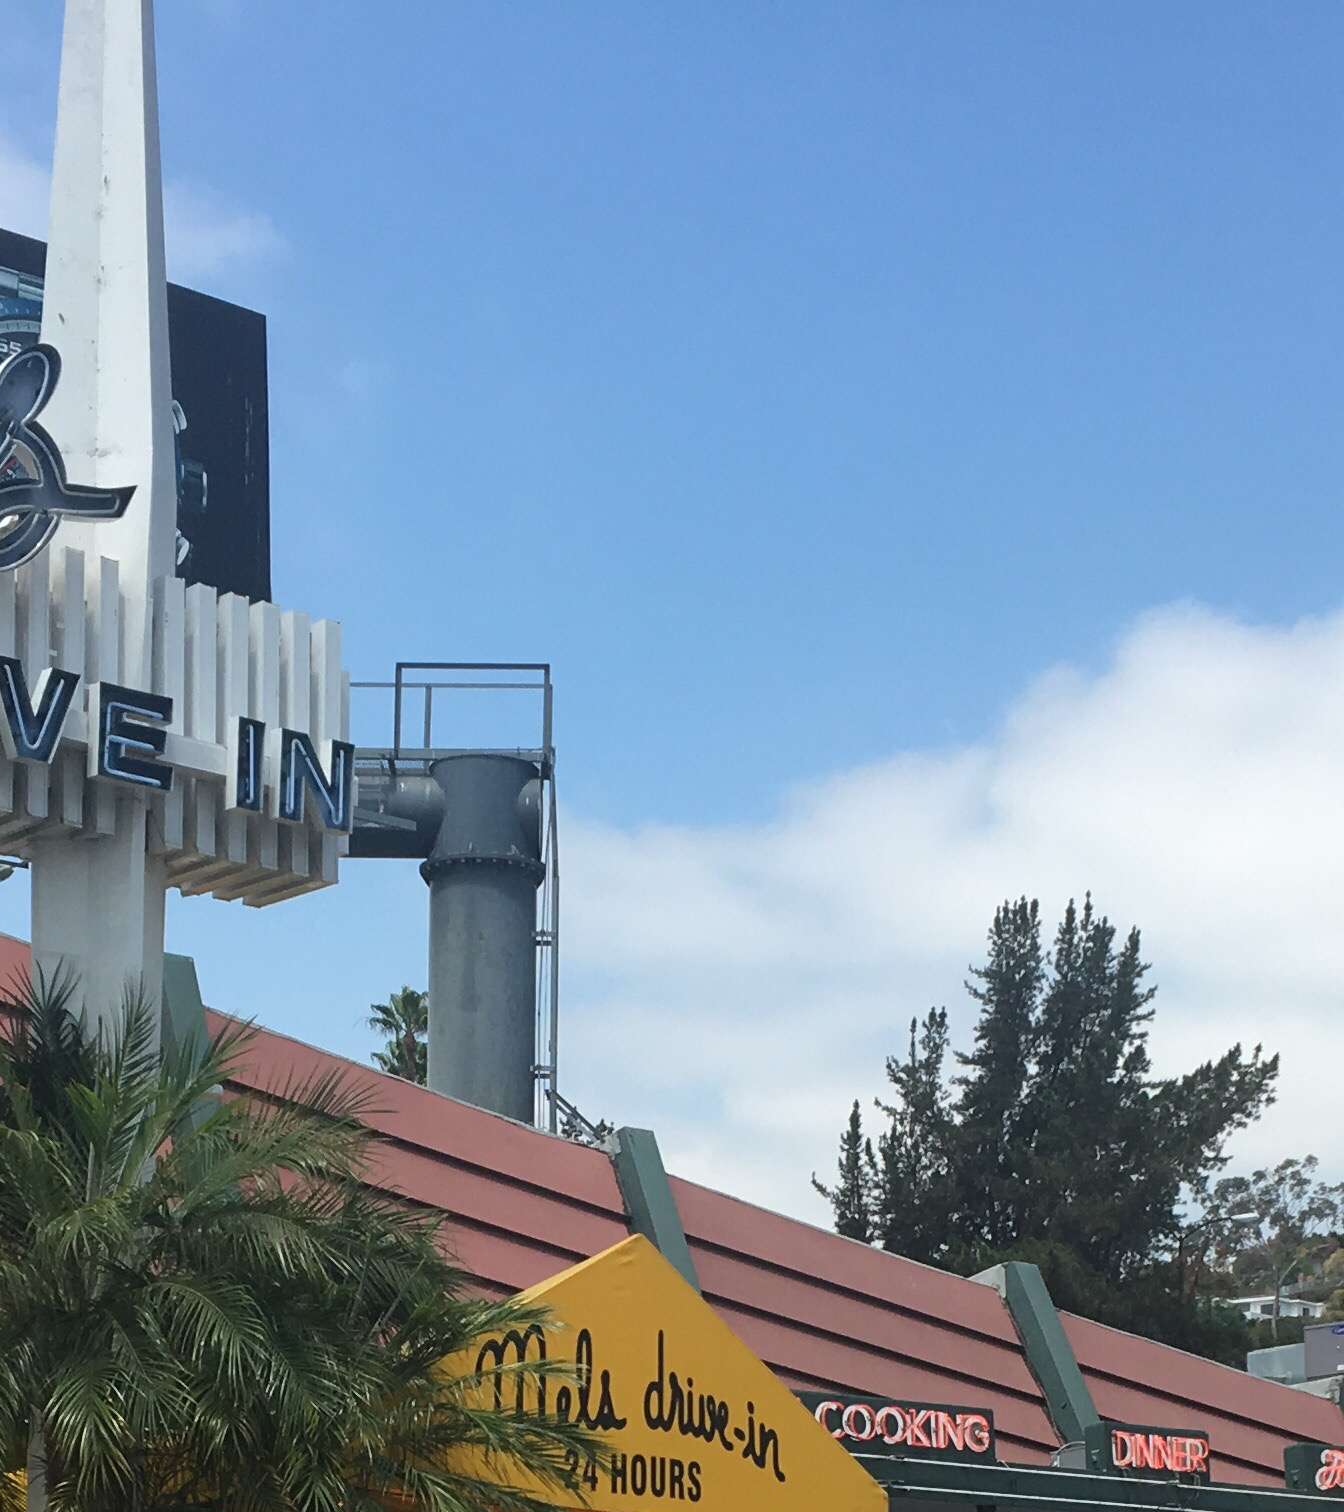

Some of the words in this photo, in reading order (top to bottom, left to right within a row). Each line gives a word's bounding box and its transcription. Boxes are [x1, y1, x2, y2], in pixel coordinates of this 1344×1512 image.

[226, 715, 356, 836] IN
[475, 1323, 627, 1430] Mels
[643, 1329, 786, 1483] drive-in
[814, 1400, 991, 1453] COOKING
[611, 1452, 702, 1503] HOURS
[1111, 1430, 1209, 1473] DINNER
